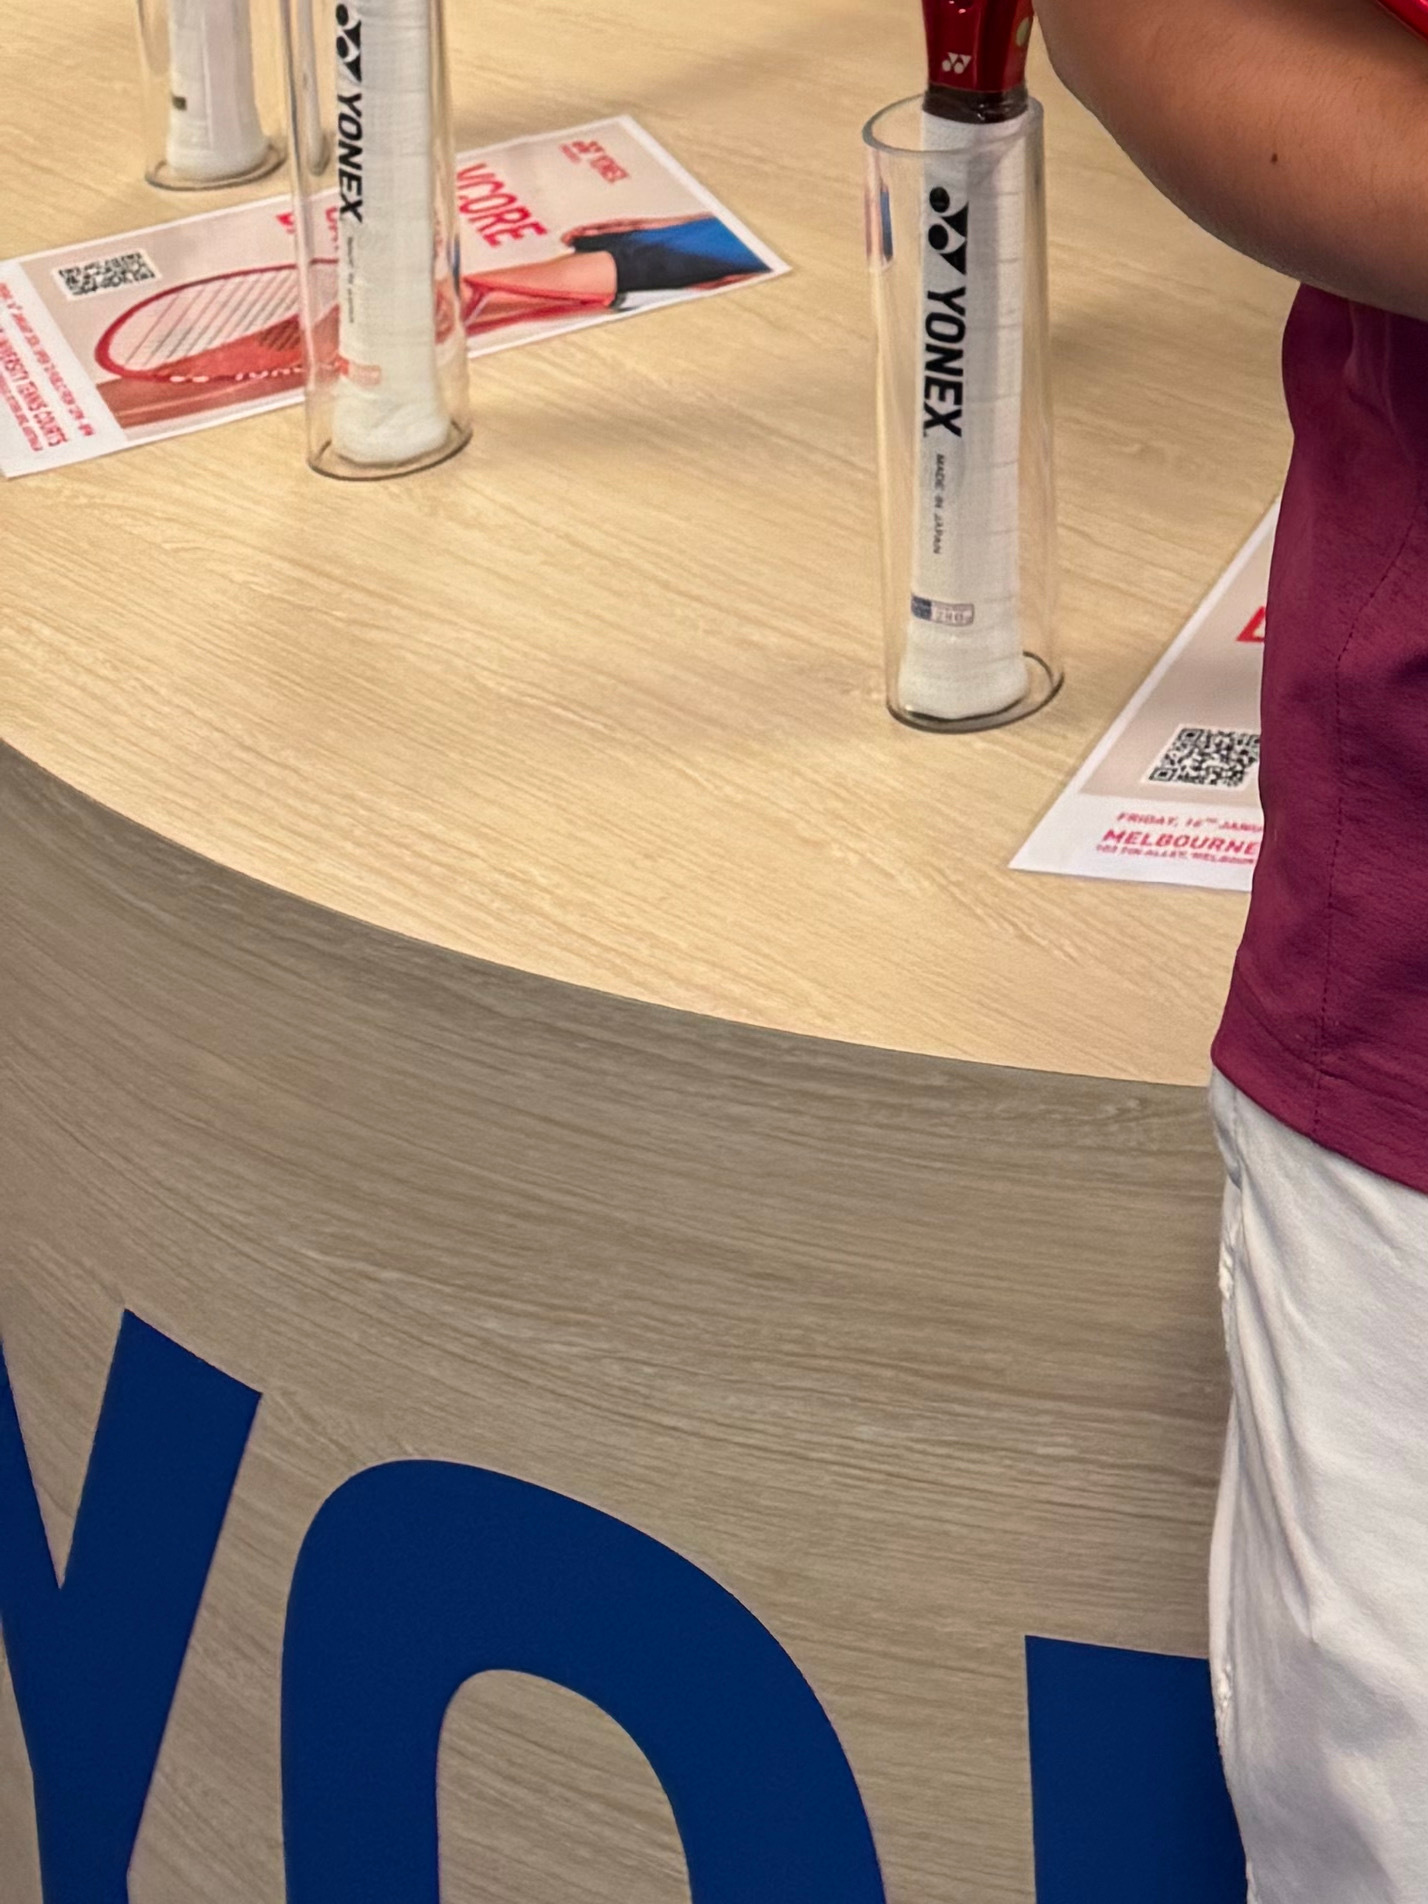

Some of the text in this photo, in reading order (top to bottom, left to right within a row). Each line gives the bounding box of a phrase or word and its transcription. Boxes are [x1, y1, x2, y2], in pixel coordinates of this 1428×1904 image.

[336, 92, 363, 224] YONEX
[456, 160, 548, 249] VCORE
[922, 285, 967, 438] YONEX
[1102, 828, 1260, 856] MELBOURNE
